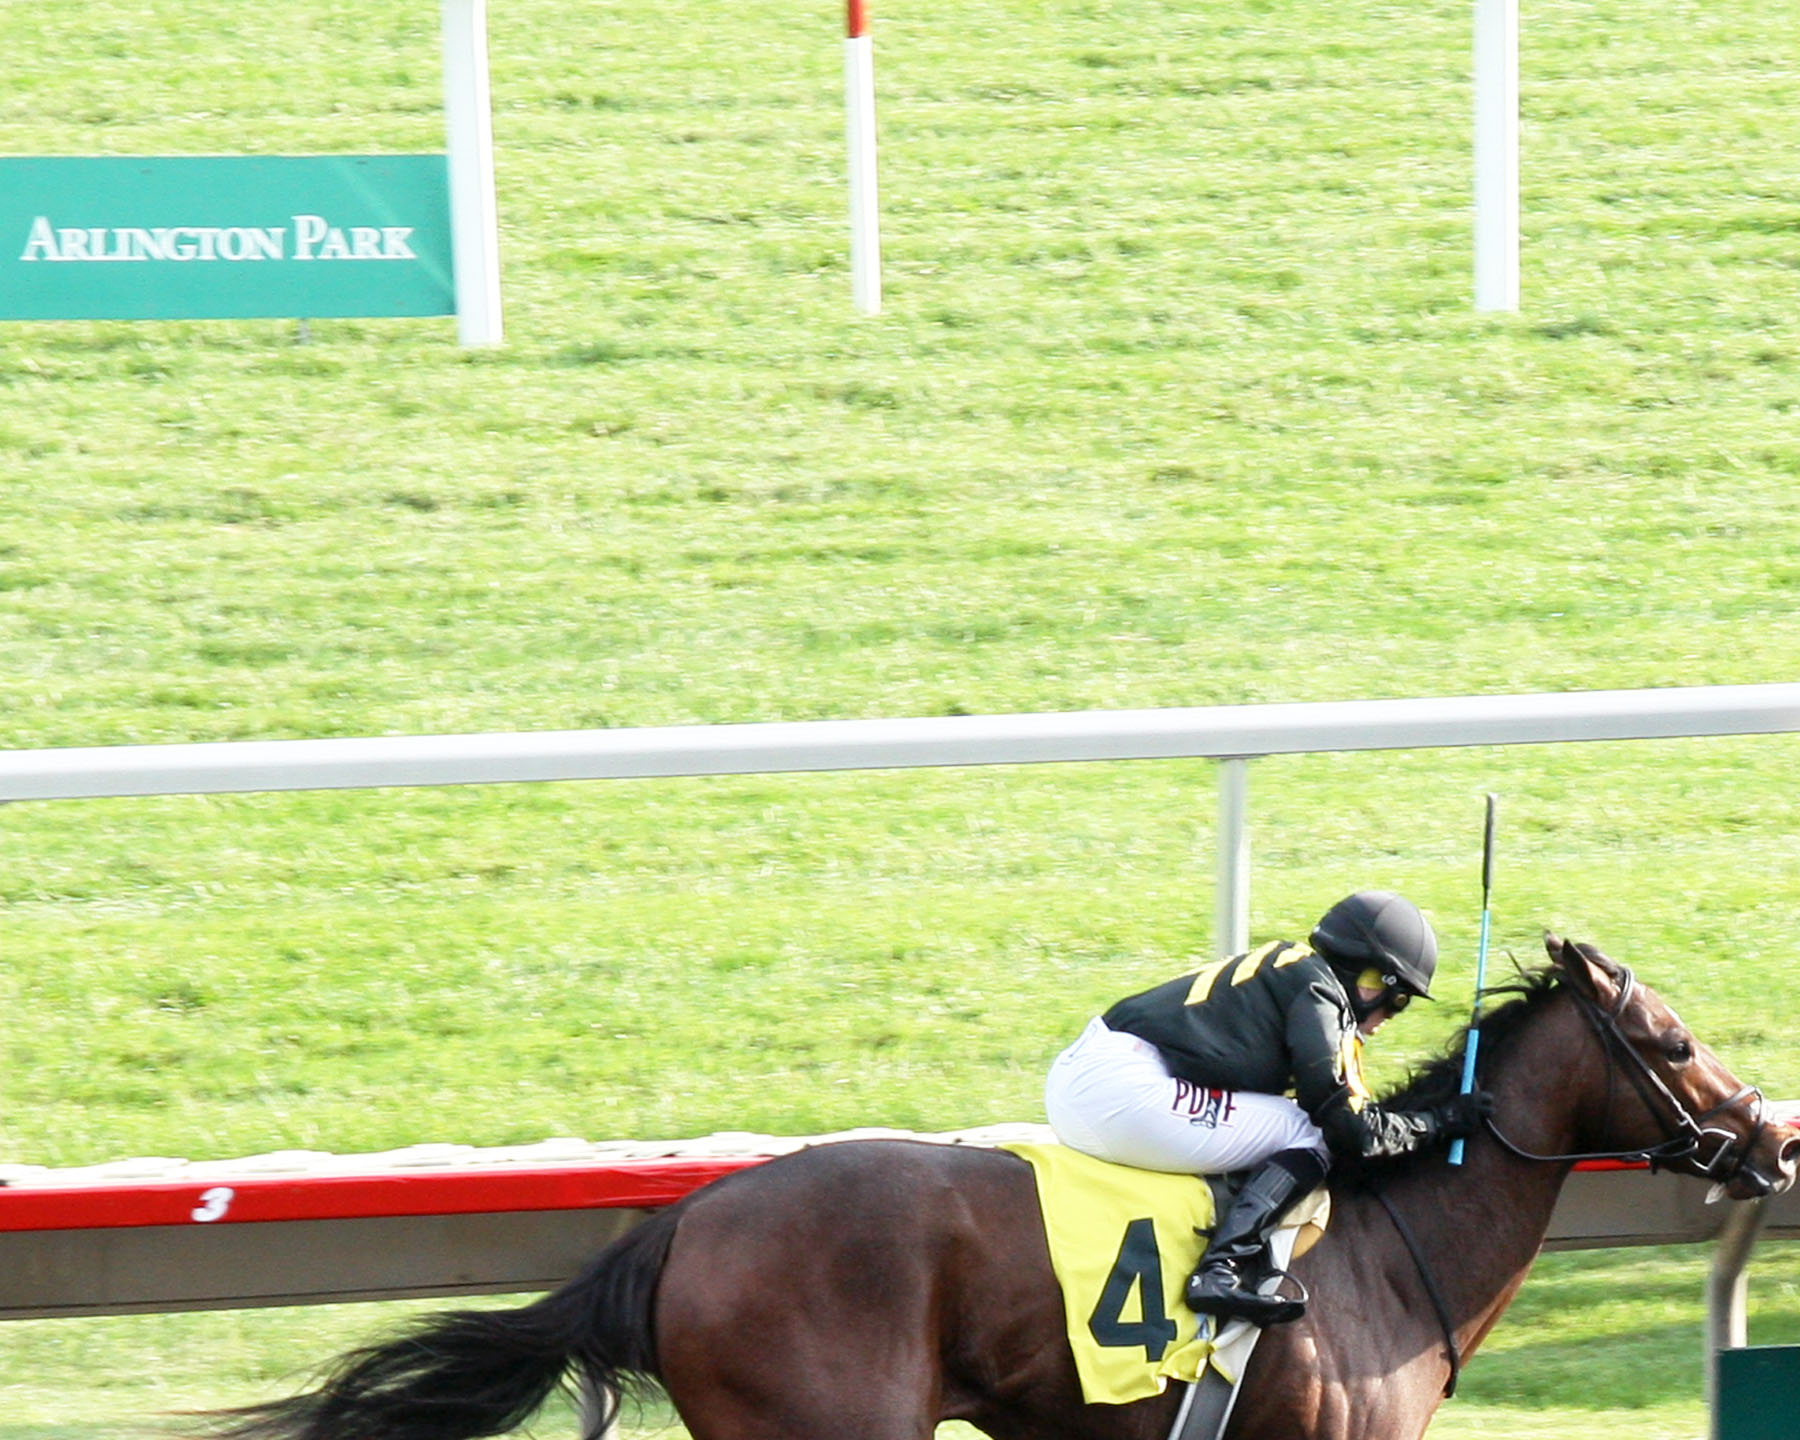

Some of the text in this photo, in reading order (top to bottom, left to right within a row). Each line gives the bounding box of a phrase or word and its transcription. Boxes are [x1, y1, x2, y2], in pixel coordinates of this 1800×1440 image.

[19, 214, 416, 261] ARLINGTON PARK
[191, 1186, 236, 1223] 3
[1088, 1217, 1178, 1363] 4
